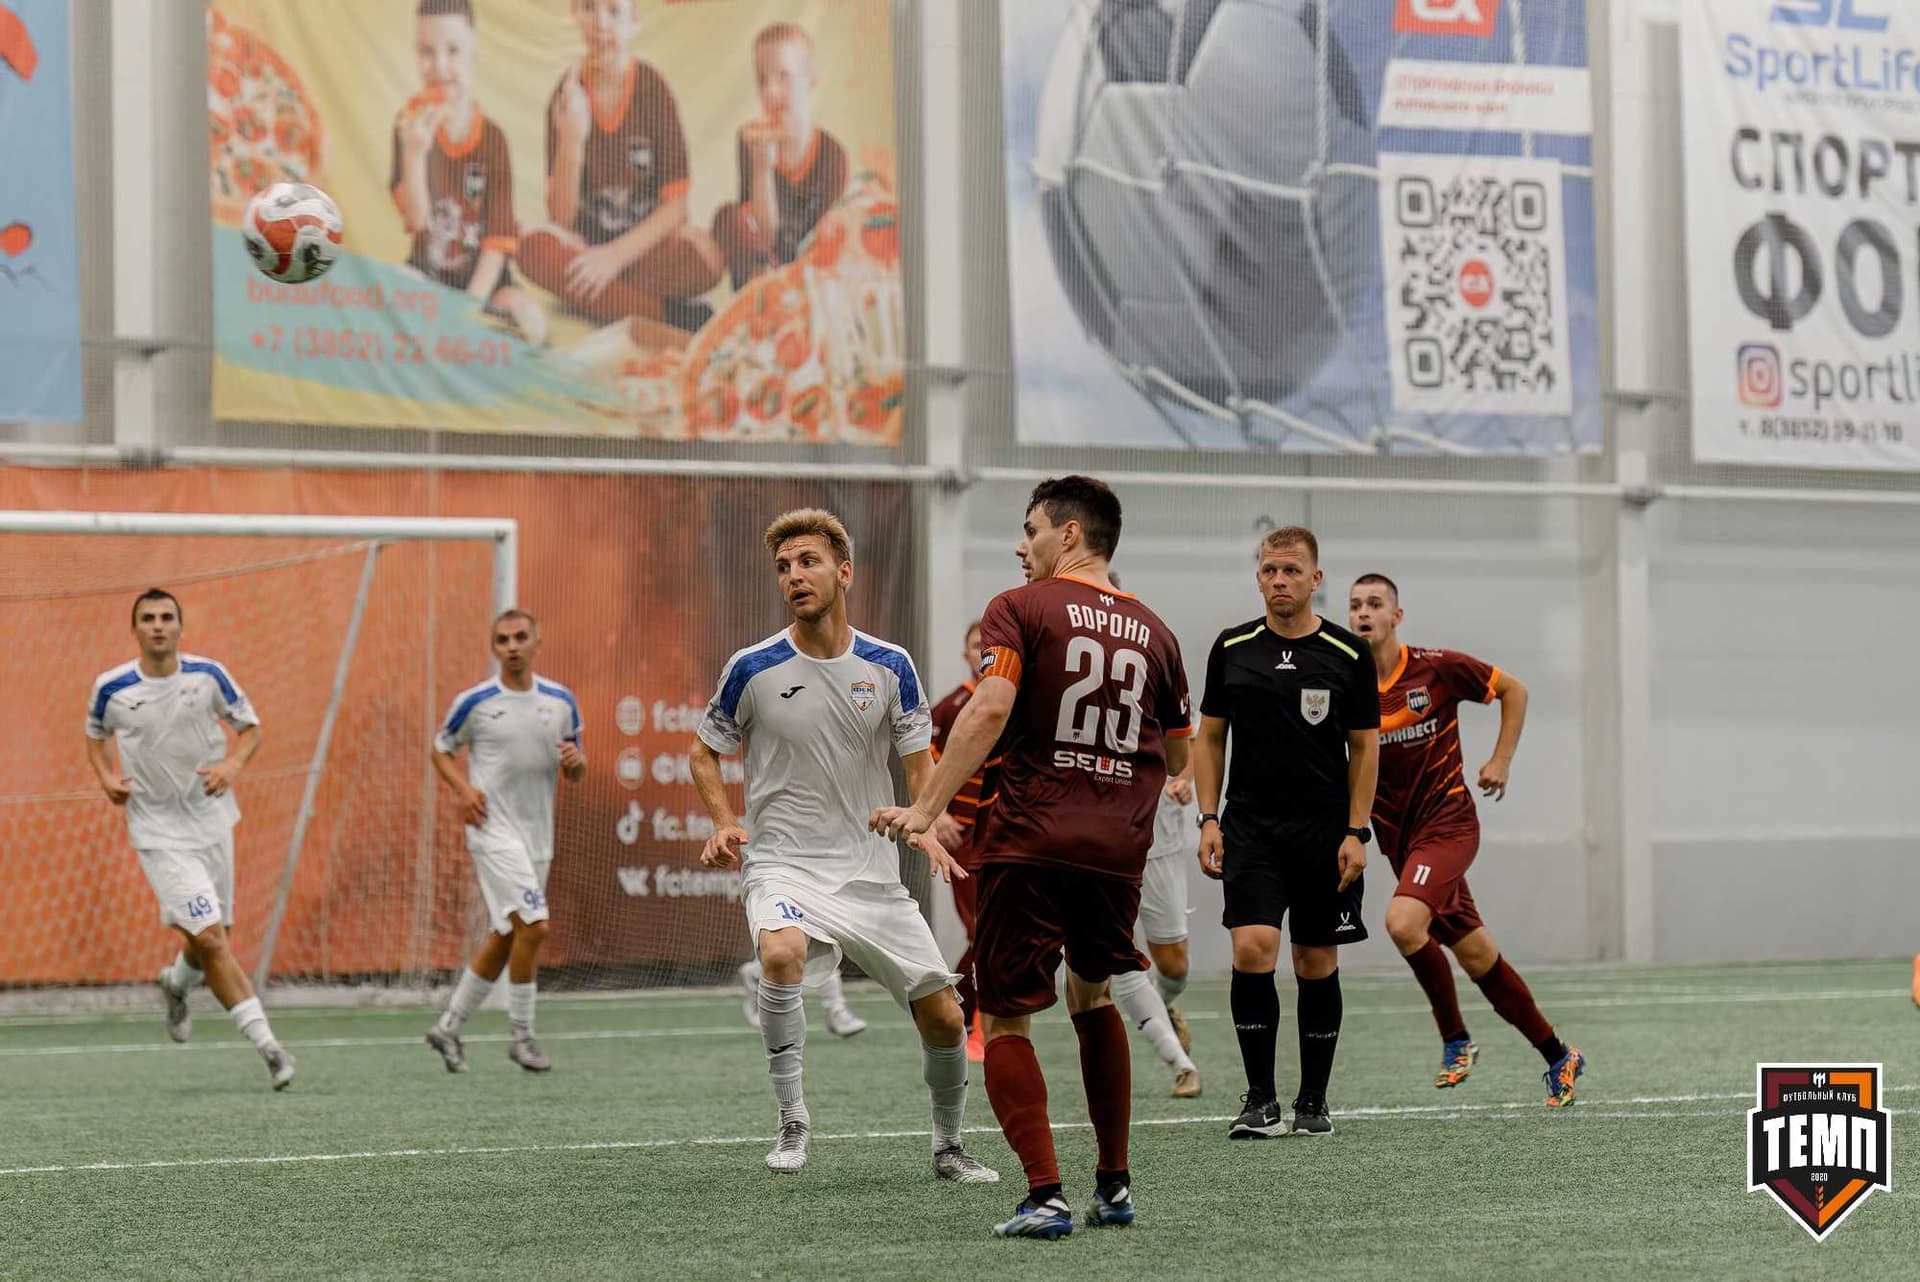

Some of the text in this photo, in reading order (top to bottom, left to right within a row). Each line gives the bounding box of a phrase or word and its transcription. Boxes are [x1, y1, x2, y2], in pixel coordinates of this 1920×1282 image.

[1725, 33, 1920, 92] SportLif
[1733, 212, 1920, 340] ФО
[1066, 604, 1150, 648] ВОРОНА
[1055, 636, 1148, 753] 23
[1053, 750, 1133, 779] SEUS
[1413, 864, 1431, 885] 11
